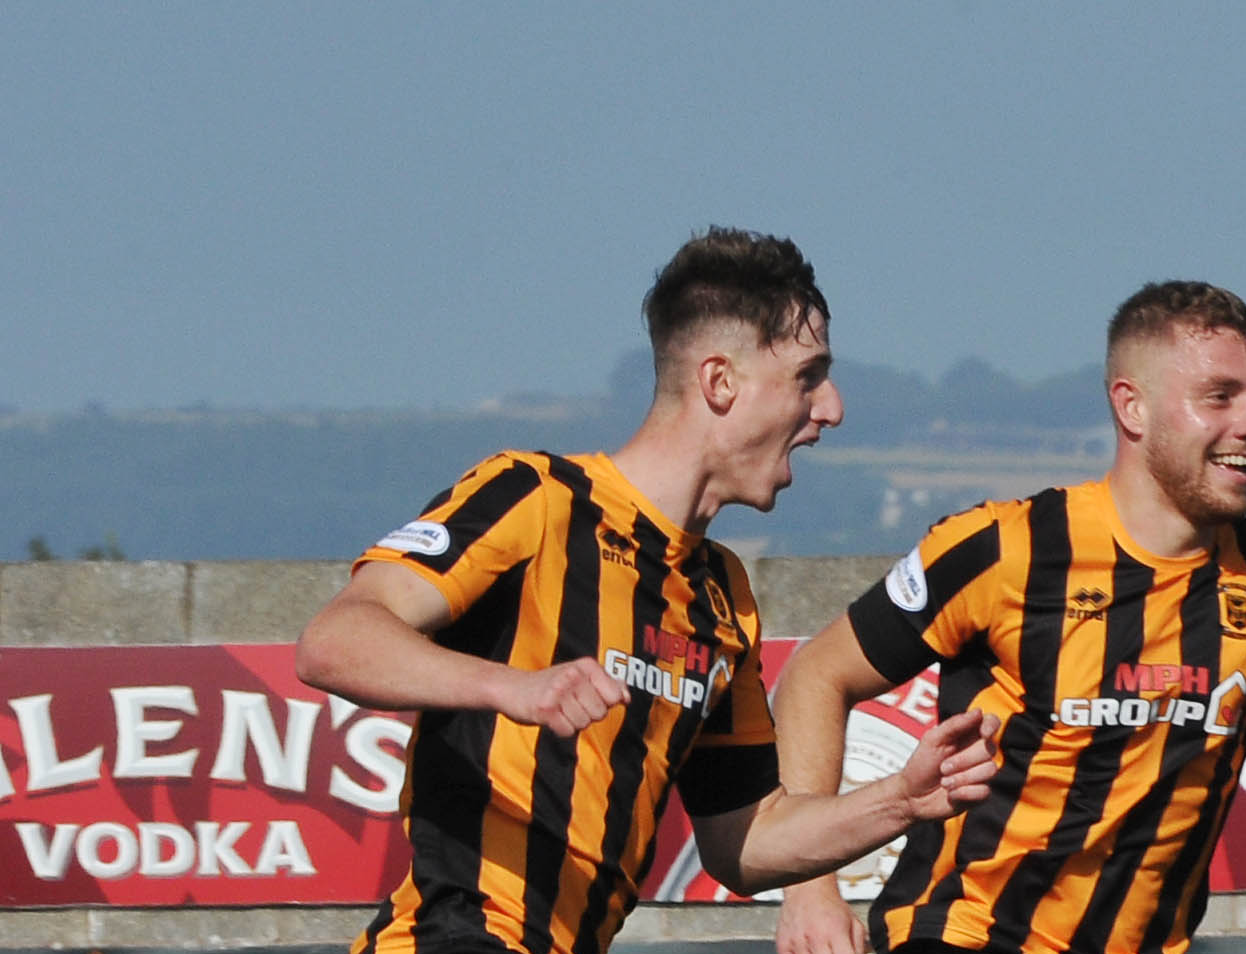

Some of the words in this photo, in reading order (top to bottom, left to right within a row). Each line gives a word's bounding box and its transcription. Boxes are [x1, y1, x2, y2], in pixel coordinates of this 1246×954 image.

[604, 648, 705, 709] GROUP
[644, 624, 710, 674] MPH
[1114, 662, 1210, 694] MPH
[0, 685, 413, 813] LEN'S
[15, 821, 318, 880] VODKA
